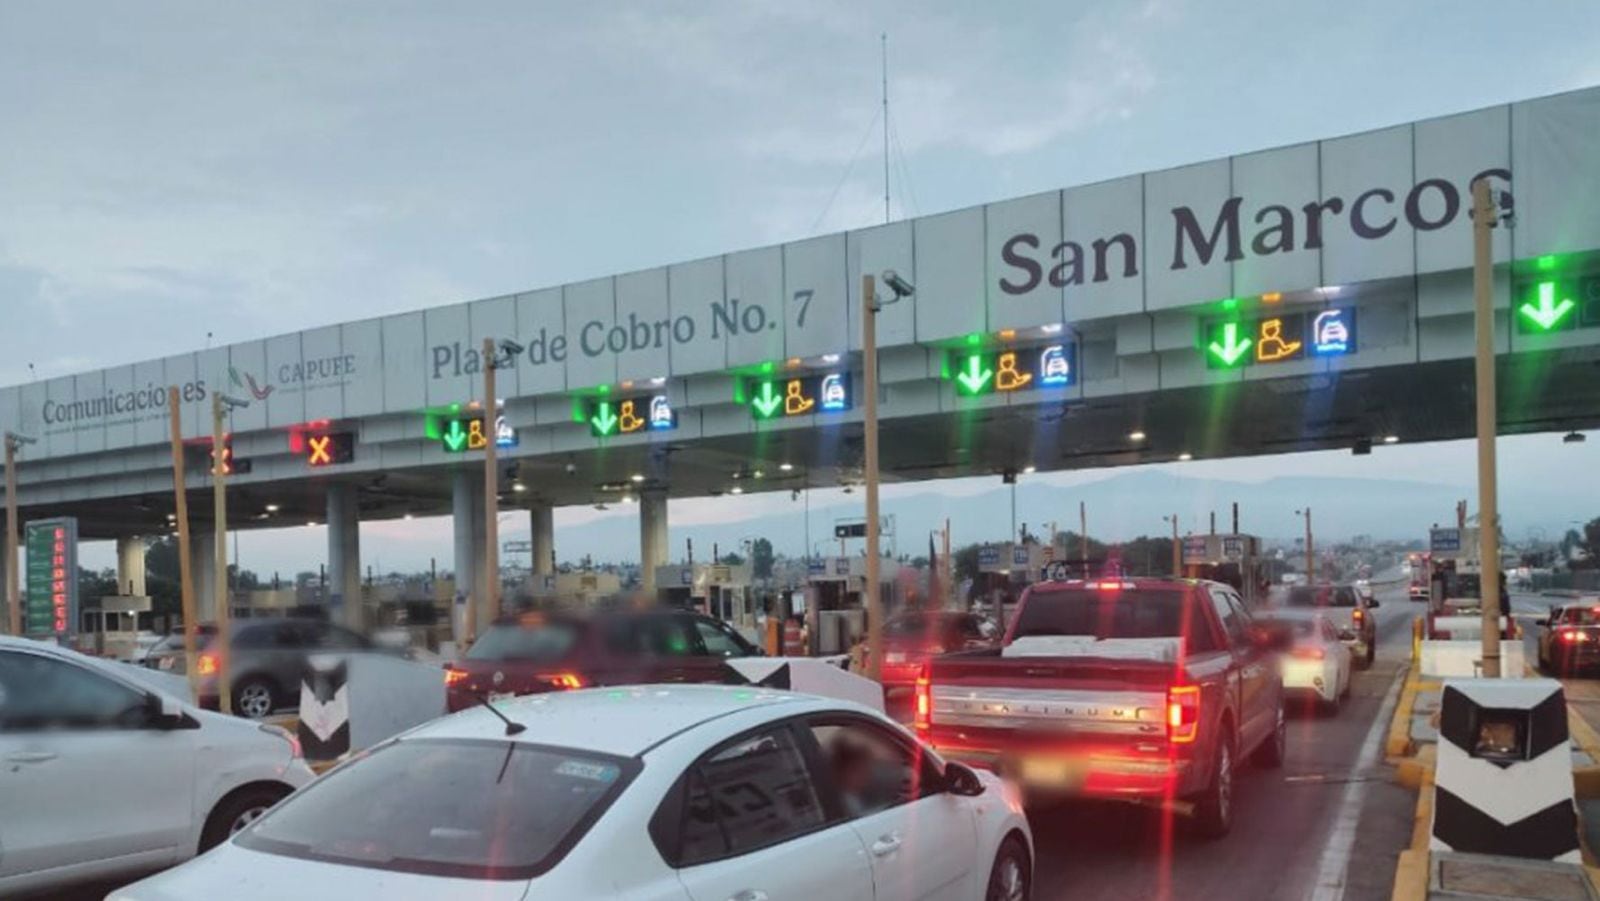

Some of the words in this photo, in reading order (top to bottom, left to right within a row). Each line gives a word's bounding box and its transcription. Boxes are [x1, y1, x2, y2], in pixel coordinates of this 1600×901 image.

[999, 233, 1138, 295] San
[432, 341, 515, 379] Plaa
[528, 328, 567, 365] de
[580, 312, 695, 357] Cobro
[710, 299, 776, 340] No.
[793, 290, 814, 328] 7
[278, 355, 356, 384] CAPUFE
[42, 379, 206, 425] Comunicacioes
